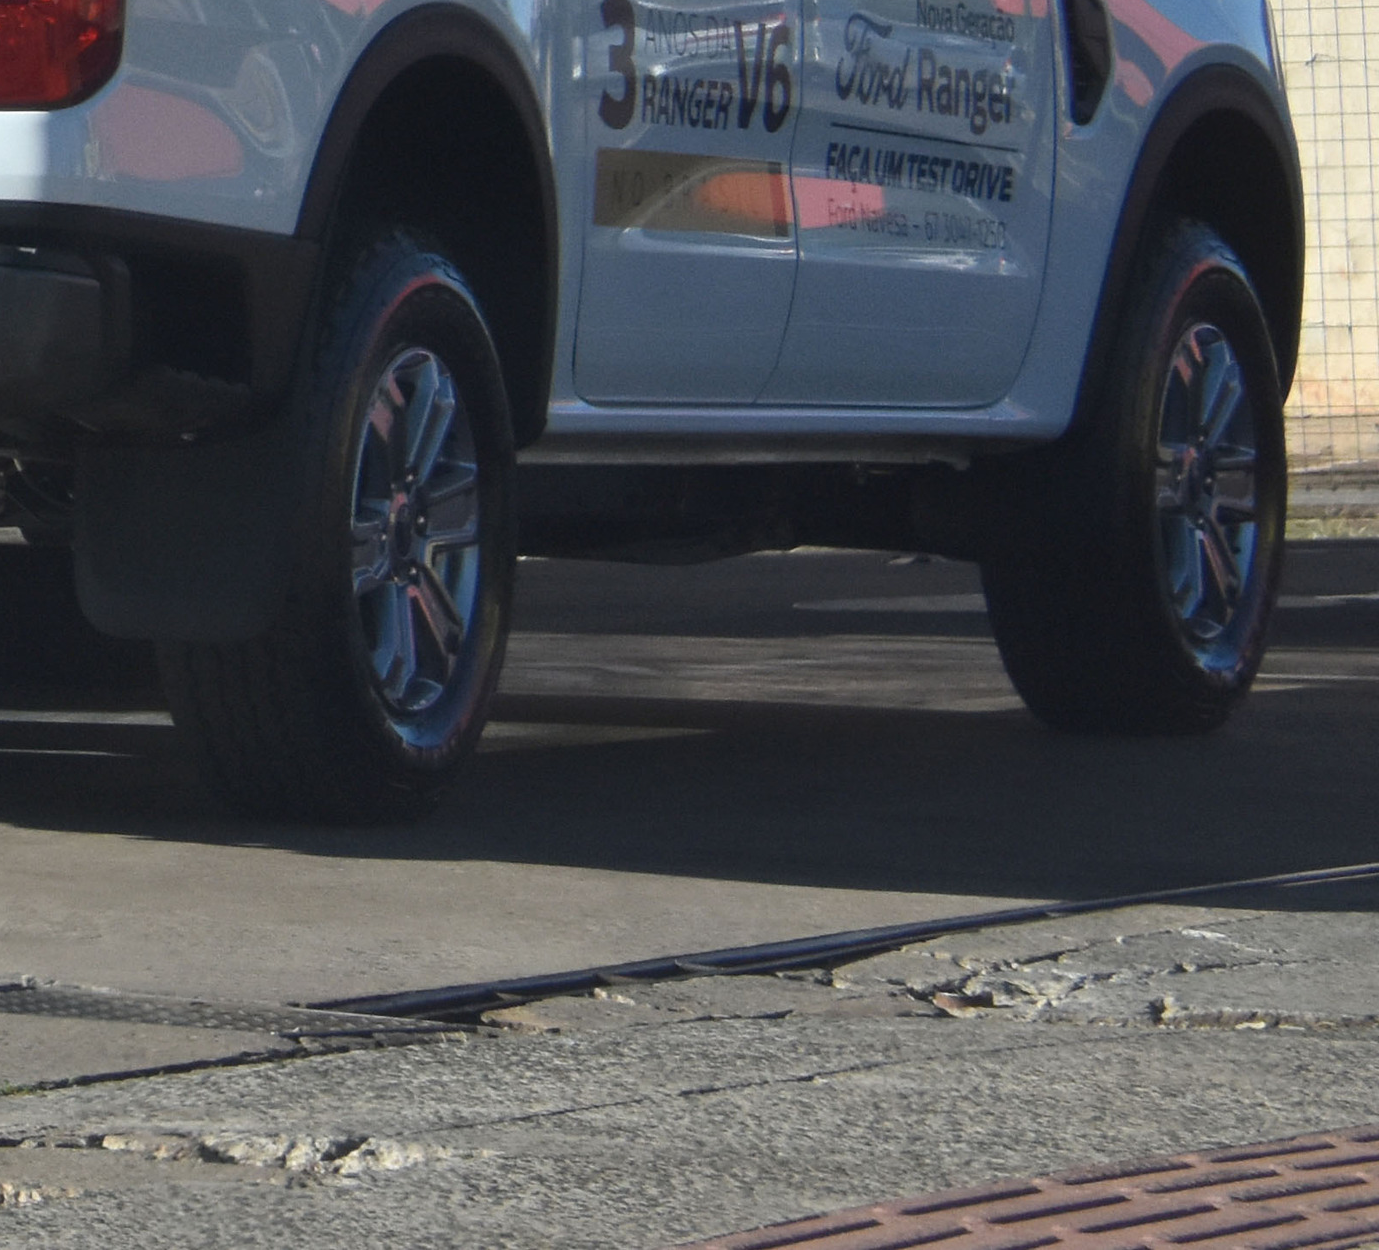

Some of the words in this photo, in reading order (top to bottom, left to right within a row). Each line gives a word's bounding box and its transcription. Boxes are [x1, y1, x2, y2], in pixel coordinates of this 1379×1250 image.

[645, 9, 698, 57] ANOS
[642, 73, 733, 130] RANGER
[733, 20, 792, 133] V6
[836, 13, 911, 110] Ford
[917, 48, 1015, 136] Ranger
[826, 142, 870, 193] FAÇA
[873, 148, 905, 187] UM
[907, 152, 952, 193] TEST
[953, 160, 1013, 203] DRIVE
